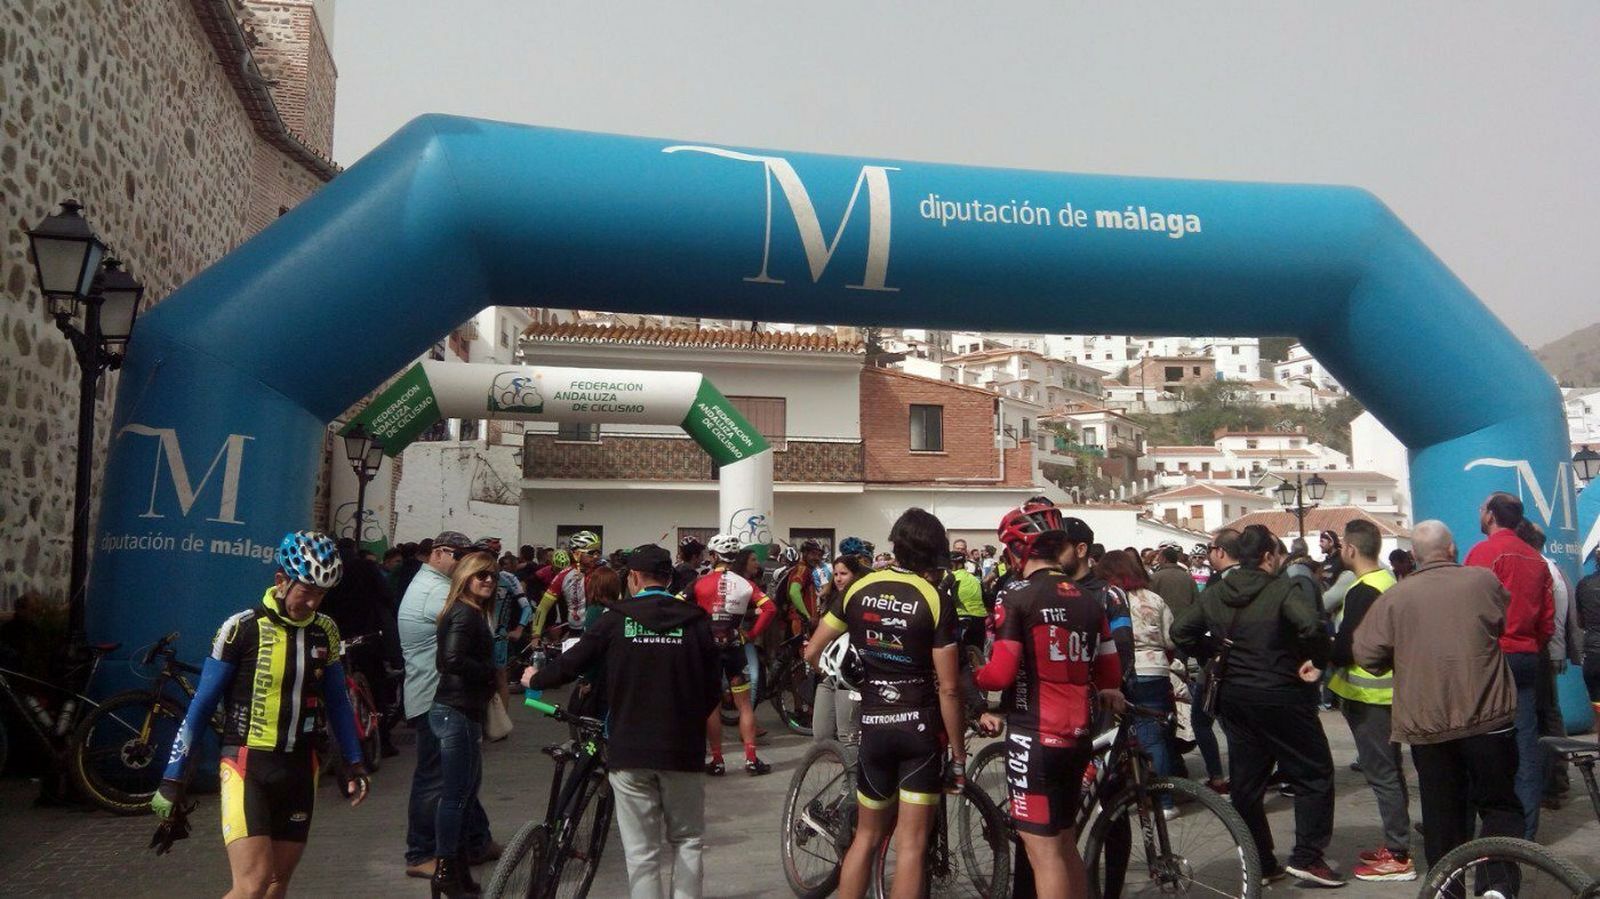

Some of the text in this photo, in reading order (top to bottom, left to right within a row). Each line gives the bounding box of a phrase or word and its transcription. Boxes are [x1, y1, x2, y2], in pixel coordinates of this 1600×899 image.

[919, 193, 1202, 238] diputación de málaga
[554, 391, 617, 402] ANDALUZA
[572, 403, 645, 413] DE CICLISMO
[373, 405, 411, 435] NDALUZA
[386, 396, 433, 438] DE CICLISMO
[698, 403, 734, 438] ANDALUZA
[702, 418, 743, 458] DE CICLISMO
[180, 533, 204, 552] de
[1040, 607, 1068, 623] THE
